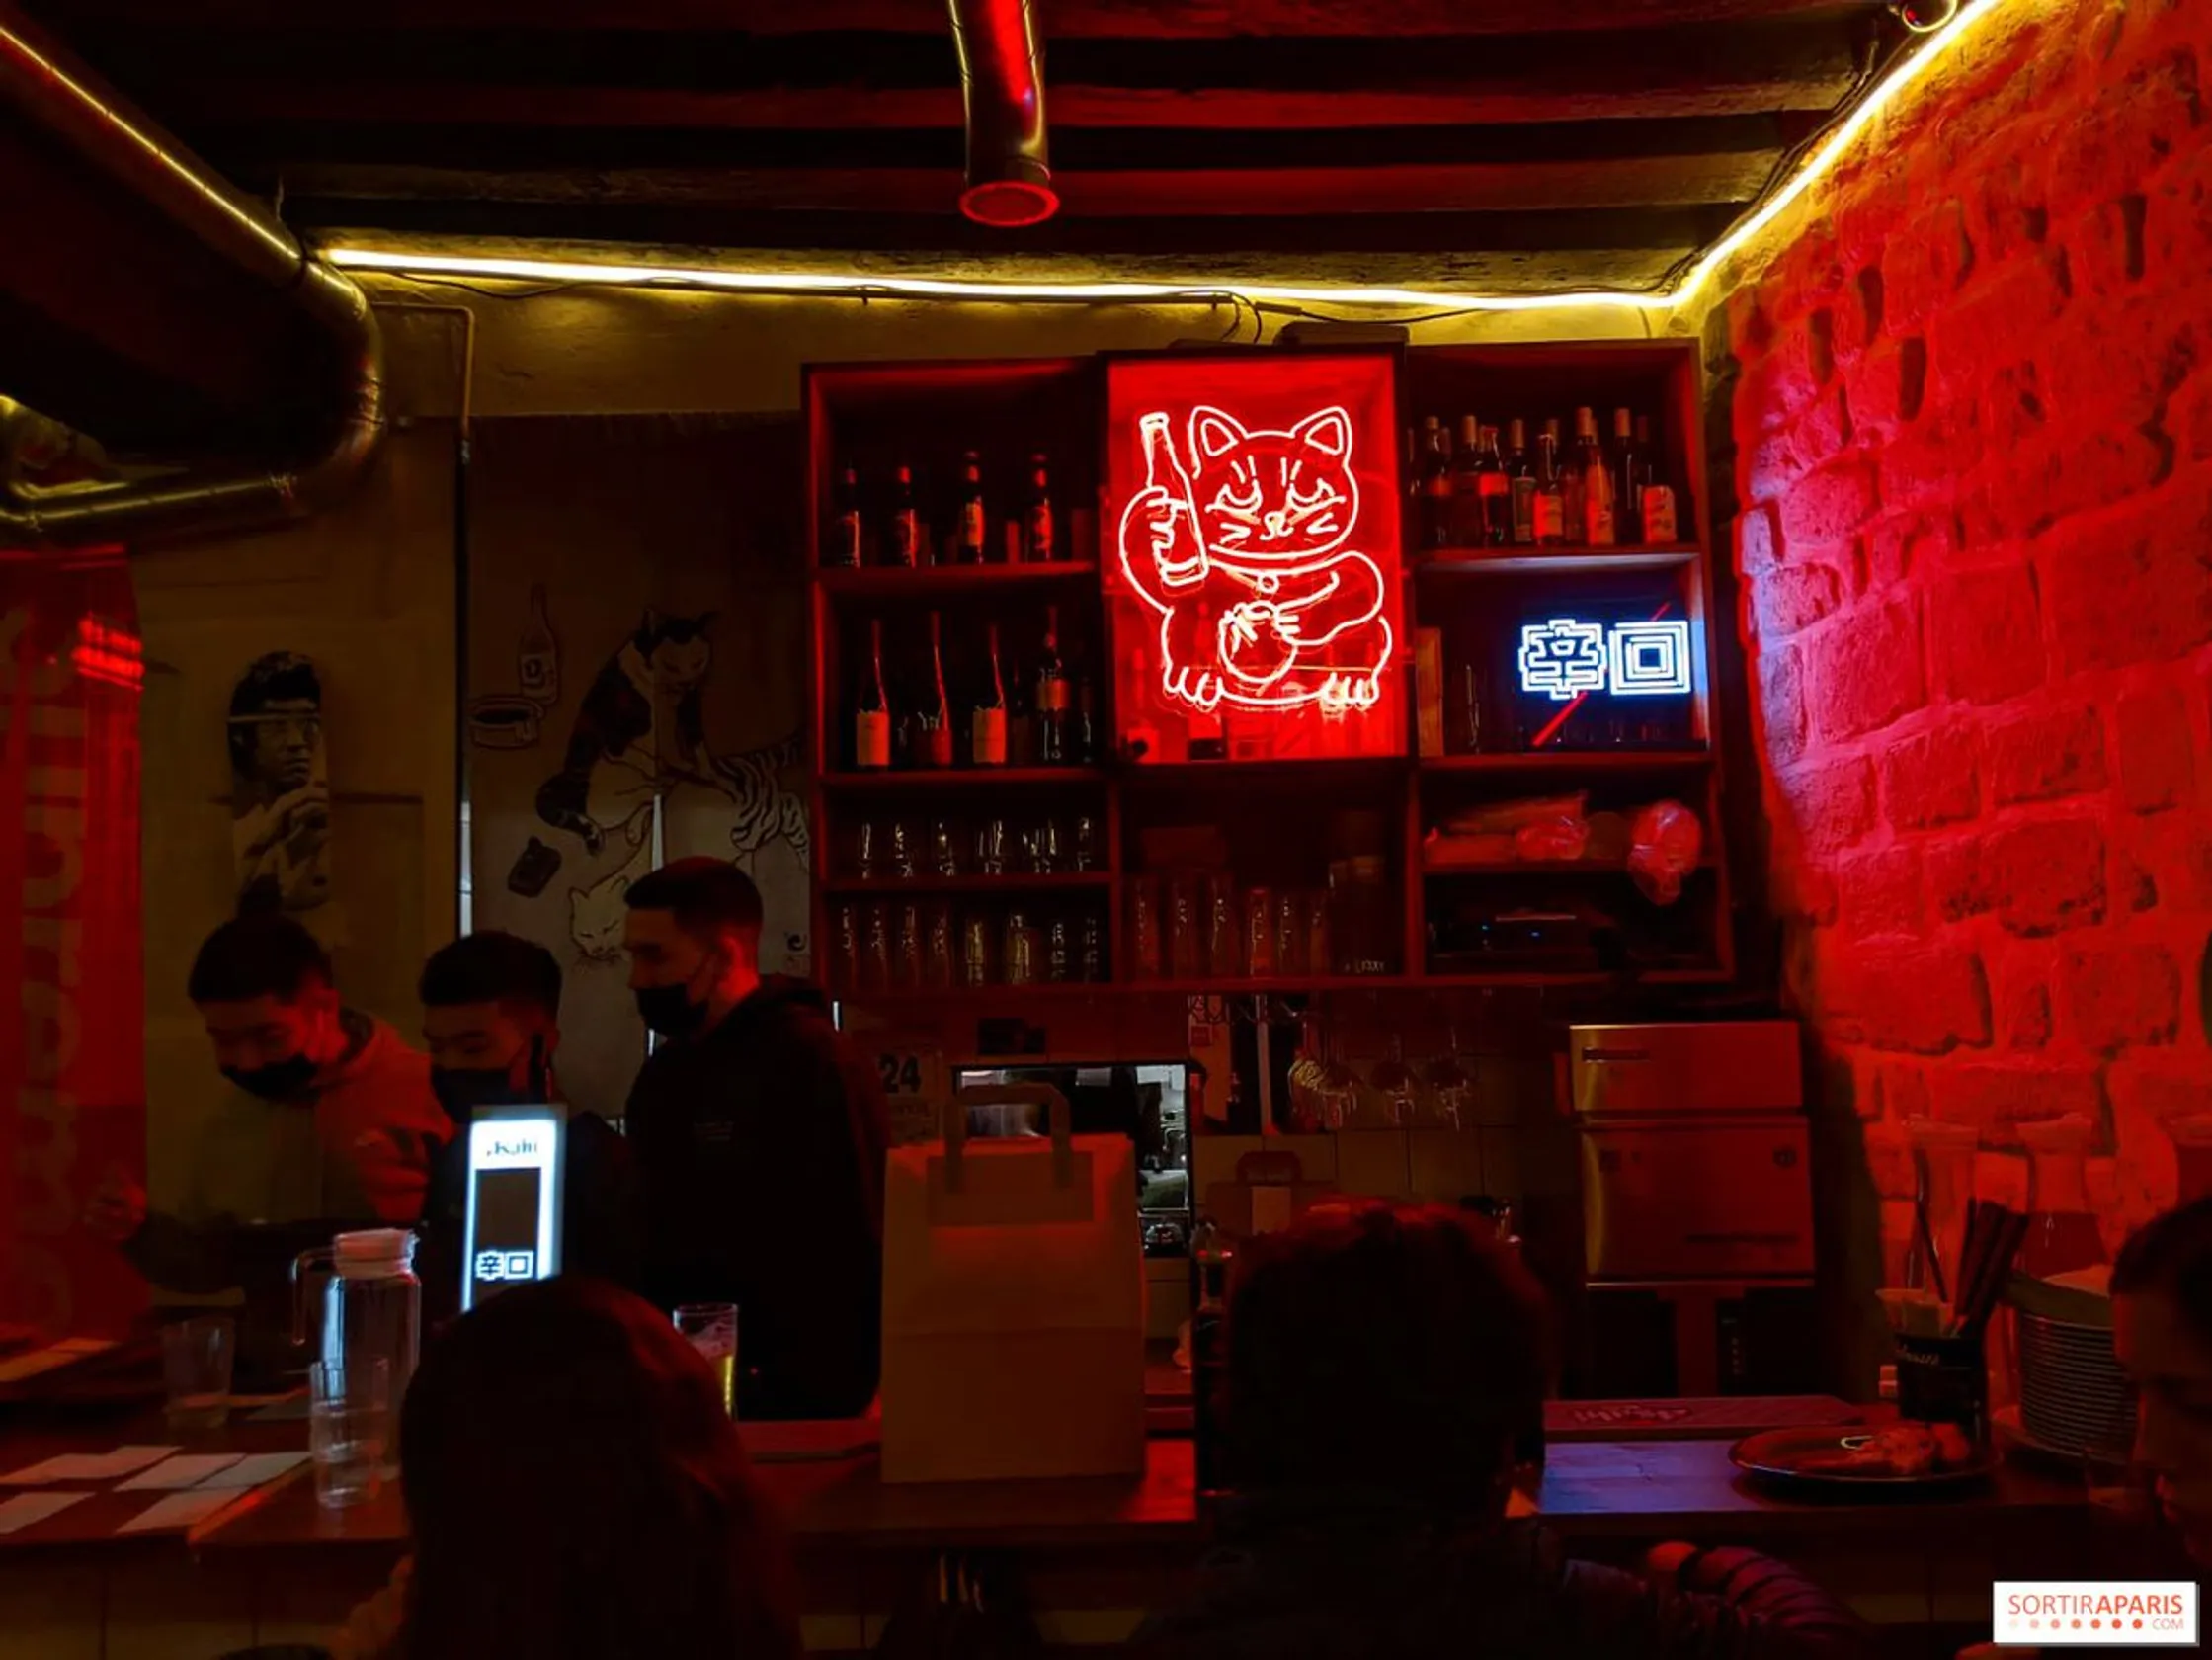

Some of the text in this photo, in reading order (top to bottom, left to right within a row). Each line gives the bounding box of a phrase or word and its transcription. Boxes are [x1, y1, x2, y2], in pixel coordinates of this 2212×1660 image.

[1518, 619, 1691, 701] 辛口
[879, 1051, 921, 1094] 24
[477, 1251, 533, 1280] 辛口
